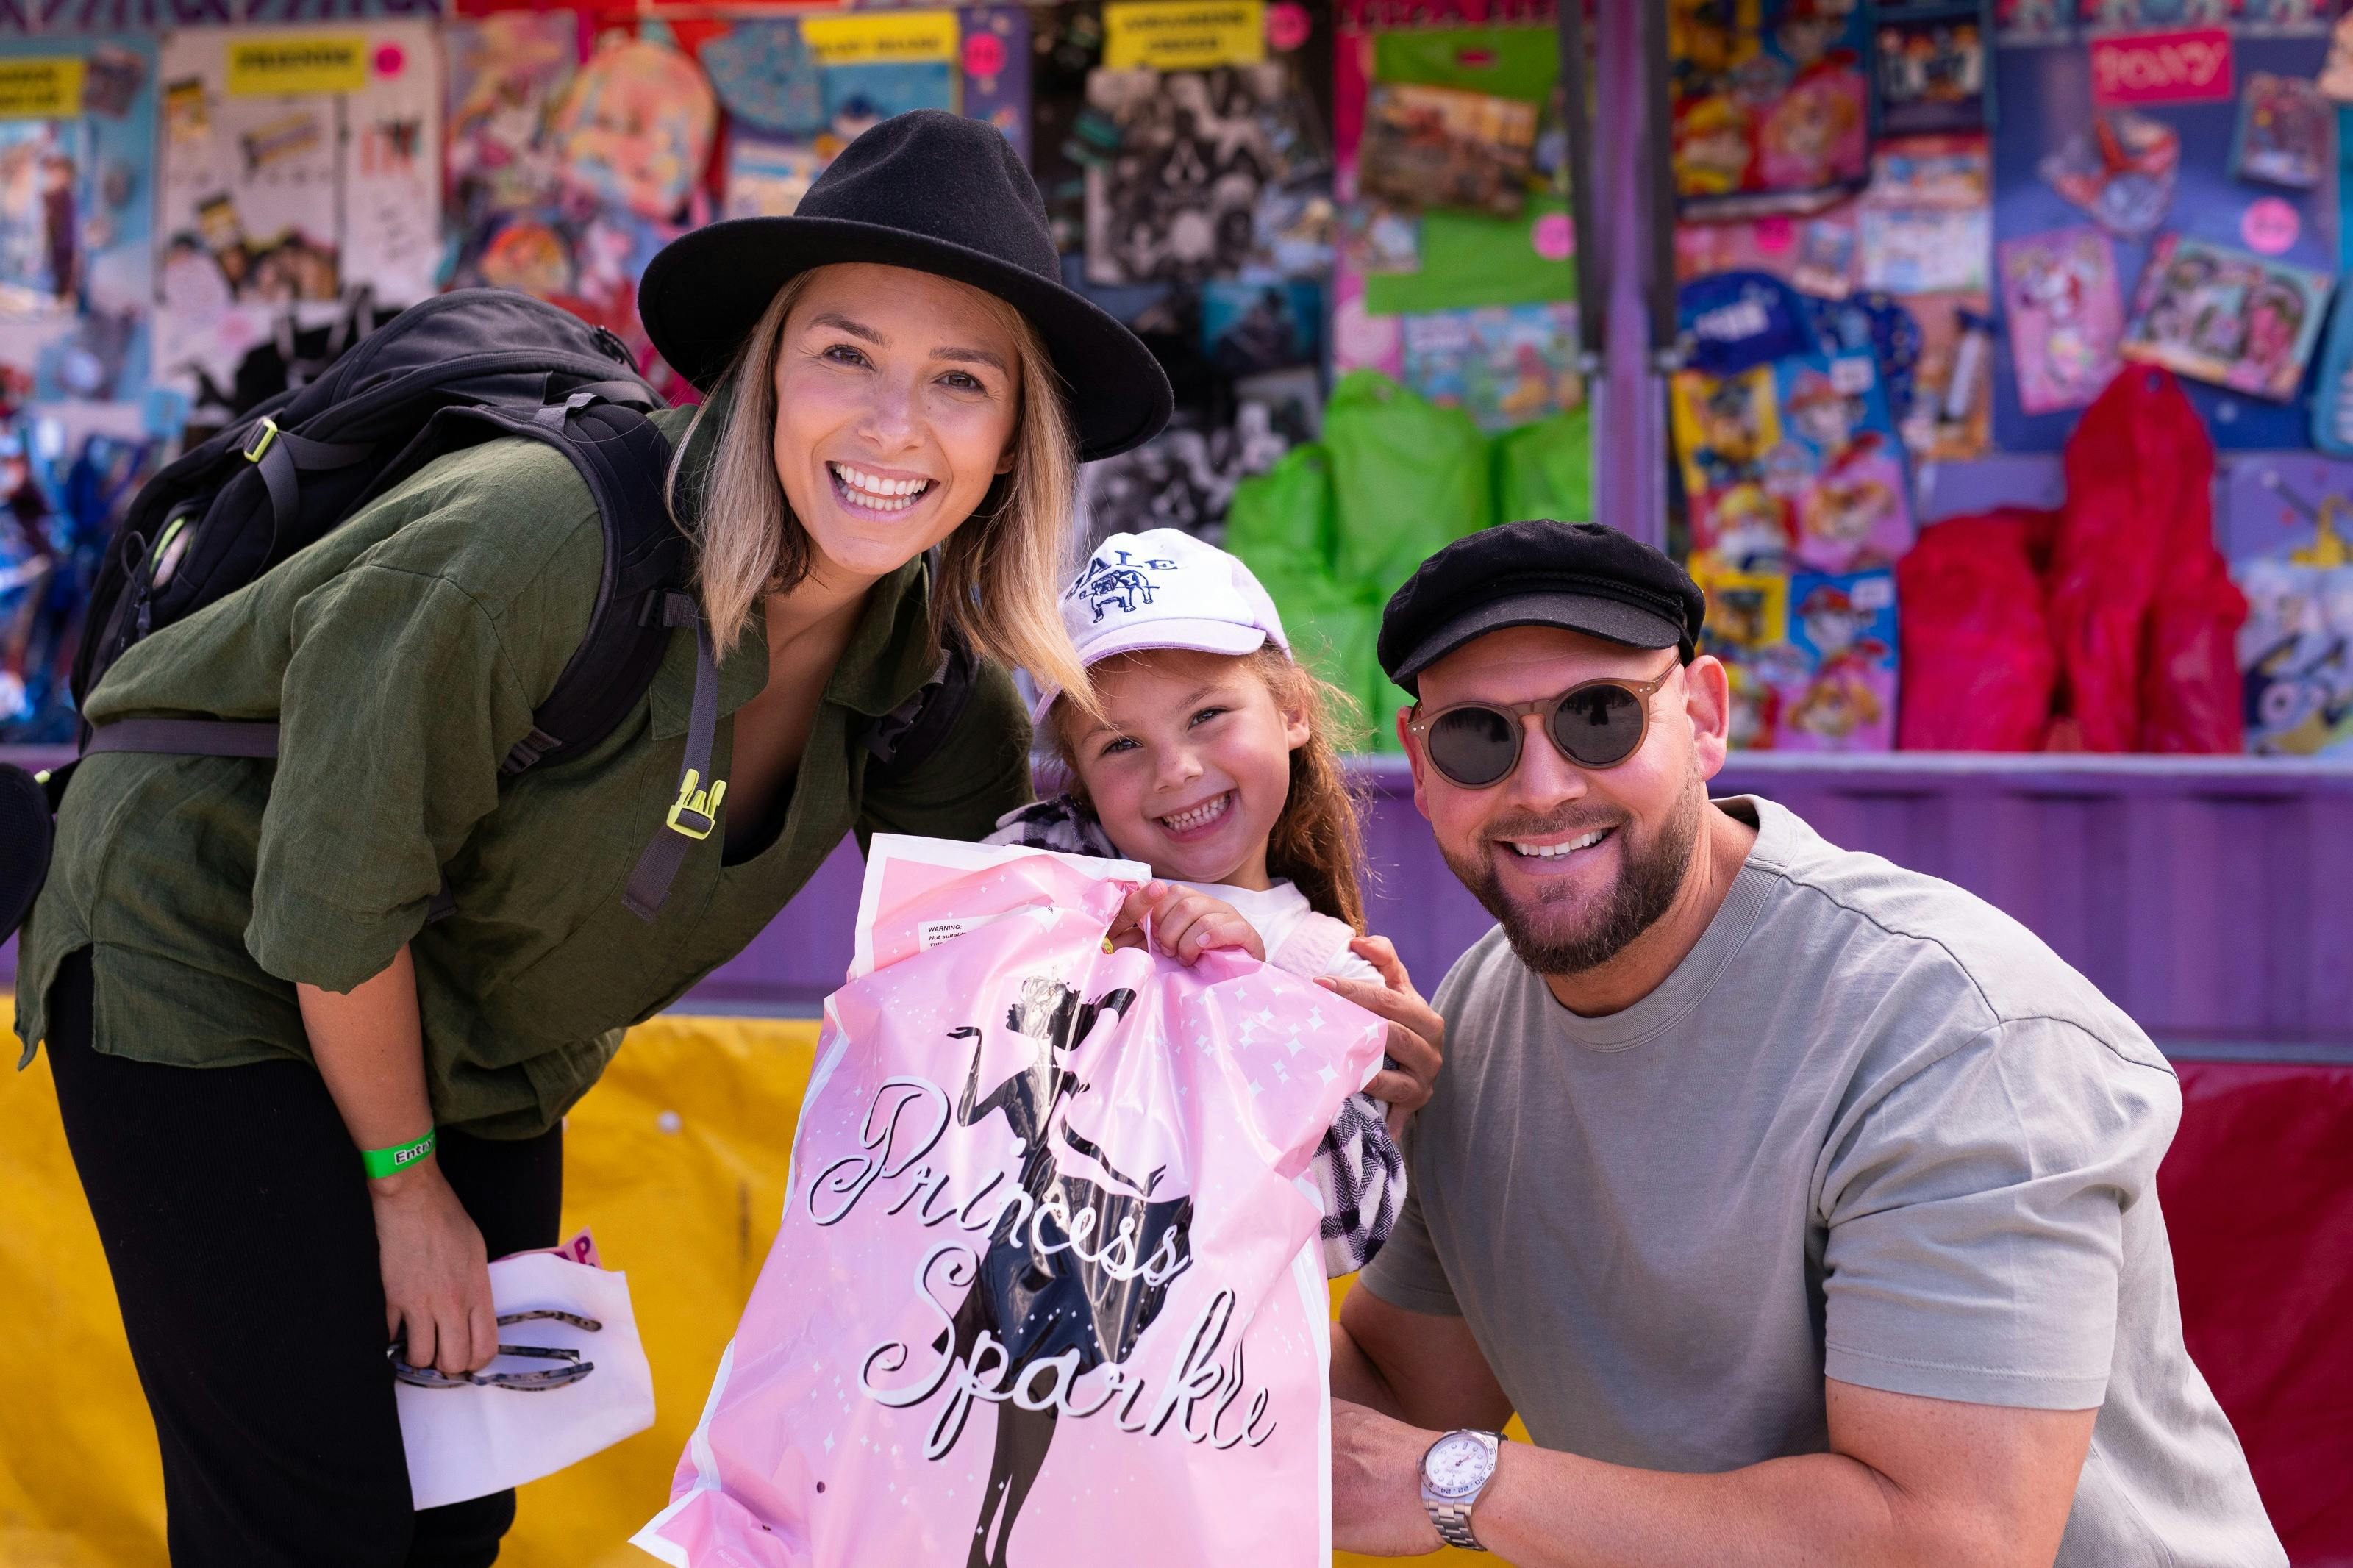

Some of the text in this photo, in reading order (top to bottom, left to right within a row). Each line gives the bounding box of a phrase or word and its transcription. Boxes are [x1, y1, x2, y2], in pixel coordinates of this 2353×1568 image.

[928, 924, 963, 932] WARNING:
[808, 1076, 1193, 1288] Princess
[857, 1239, 1277, 1460] Sparkle
